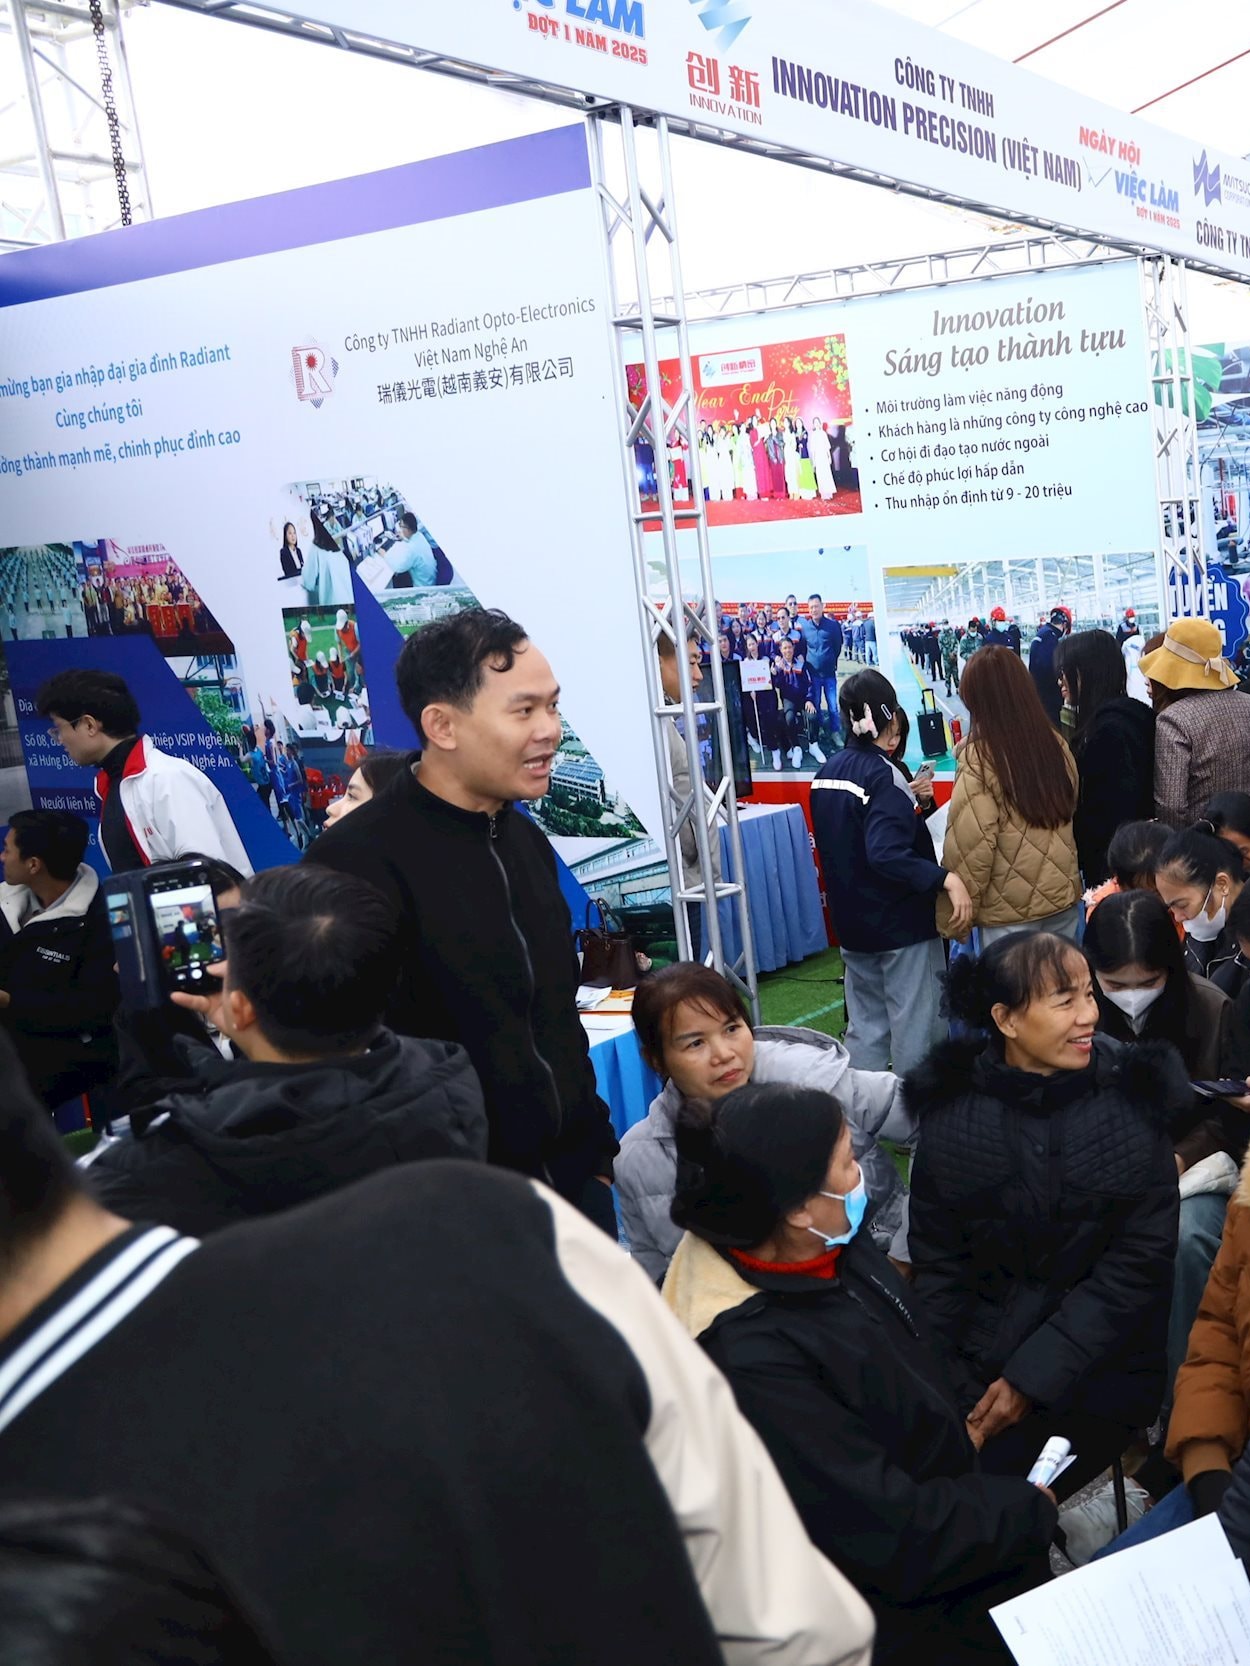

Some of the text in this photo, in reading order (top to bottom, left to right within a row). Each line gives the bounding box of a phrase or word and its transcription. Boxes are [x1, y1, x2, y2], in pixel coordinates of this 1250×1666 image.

[527, 12, 647, 65] ĐỢT 1 NĂM 2025
[685, 51, 761, 108] 创新
[894, 56, 995, 119] CÔNG TY TNHH
[689, 93, 762, 125] INNOVATION
[772, 56, 1082, 192] INNOVATION PRECISION (VIỆT NAM)
[1079, 125, 1141, 168] NGÀY HỘI
[1115, 170, 1179, 213] VIỆC LÀM
[1196, 217, 1224, 250] CÔNG
[1226, 230, 1237, 255] TY
[344, 297, 596, 352] Công ty TNHH Radiant Opto-Electronics
[932, 297, 1066, 337] Innovation
[31, 376, 53, 396] bạn
[56, 370, 73, 393] gia
[75, 365, 105, 388] nhập
[108, 360, 126, 384] đại
[129, 358, 147, 381] gia
[150, 352, 178, 373] đình
[180, 344, 231, 368] Radiant
[414, 336, 528, 370] Việt Nam Nghệ An
[883, 328, 1126, 377] Sáng tạo thành tựu
[376, 356, 575, 405] 瑞儀光電(越南義安)有限公司
[876, 383, 1063, 414] Môi trường làm việc năng động
[55, 398, 143, 429] Cùng chúng tôi
[879, 400, 1148, 438] Khách hàng là những công ty công nghệ cao
[23, 451, 57, 471] thành
[59, 446, 92, 470] mạnh
[94, 443, 117, 464] mẽ,
[118, 438, 152, 459] chinh
[154, 435, 185, 458] phục
[218, 429, 241, 446] cao
[881, 433, 1049, 463] Cơ hội đi đạo tạo nước ngoài
[883, 460, 1025, 486] Chế độ phúc lợi hấp dẫn
[885, 496, 907, 510] Thu
[910, 493, 940, 510] nhập
[961, 489, 988, 507] định
[991, 488, 1004, 502] từ
[1006, 487, 1014, 500] 9
[1024, 485, 1040, 499] 20
[1042, 483, 1073, 500] triệu
[18, 699, 33, 715] Địa
[24, 732, 36, 747] Số
[36, 734, 50, 749] 08,
[150, 732, 174, 750] ghiệp
[175, 733, 196, 746] VSIP
[198, 730, 222, 750] Nghệ
[29, 754, 38, 767] xã
[39, 754, 62, 770] Hưng
[191, 753, 216, 771] Nghệ
[218, 754, 233, 768] An.
[40, 795, 96, 813] Người liên hệ
